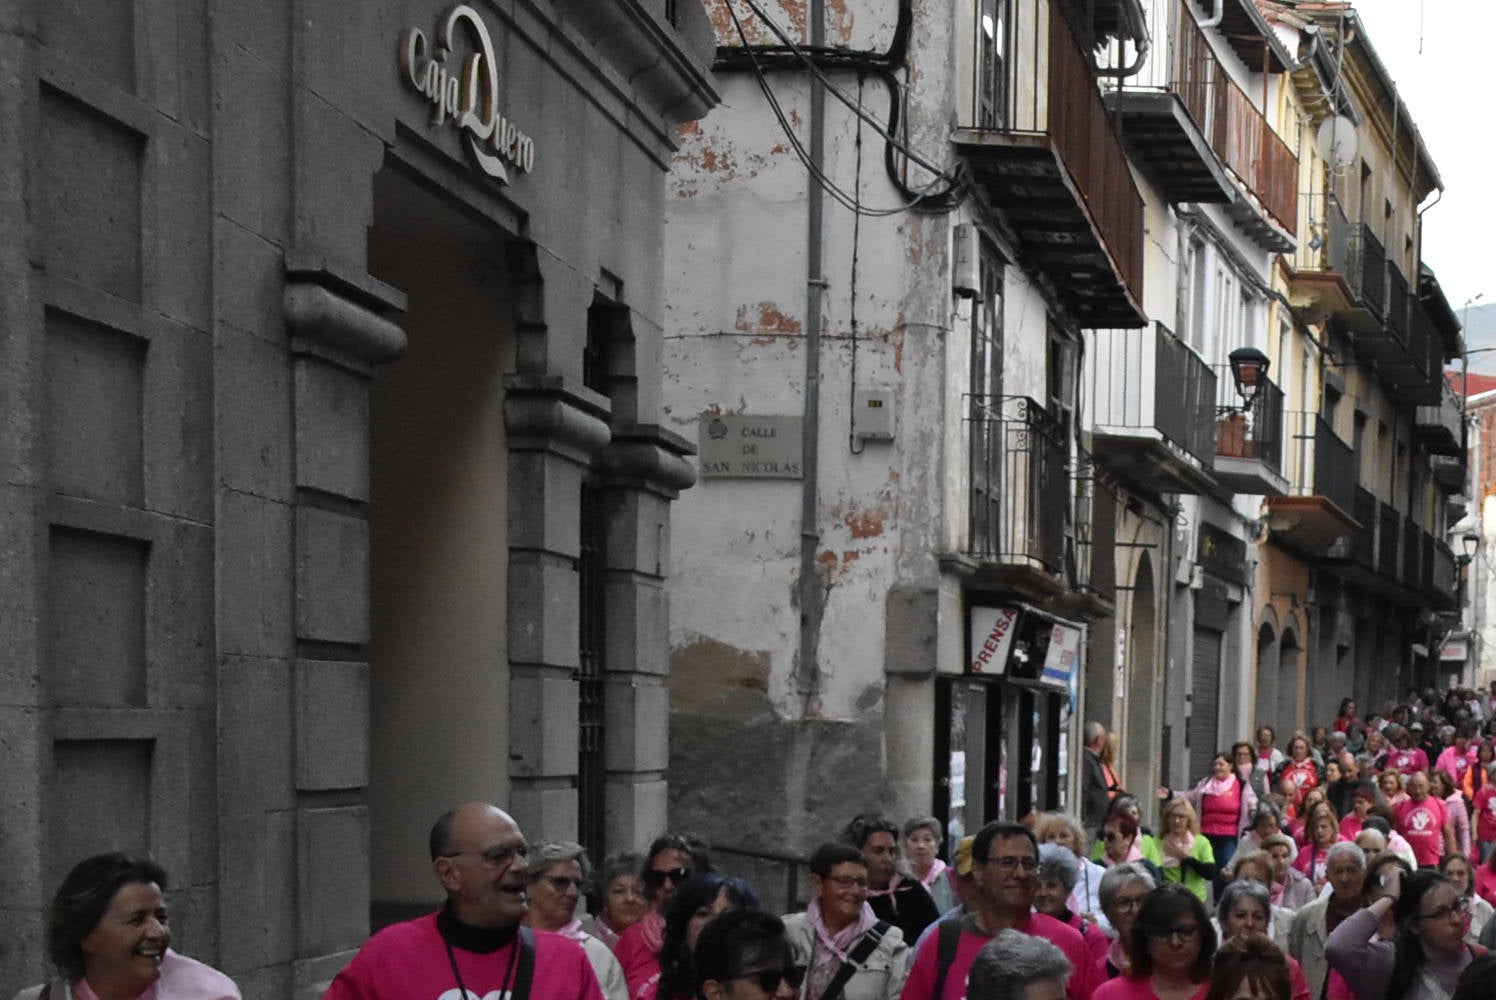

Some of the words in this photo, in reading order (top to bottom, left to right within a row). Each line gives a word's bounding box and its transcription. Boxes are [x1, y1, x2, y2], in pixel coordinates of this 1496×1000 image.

[405, 27, 460, 126] Caja
[446, 4, 535, 178] Duero
[741, 427, 777, 439] CALLE
[742, 443, 758, 455] DE
[702, 461, 730, 474] SAN
[970, 607, 1019, 673] PRENSA
